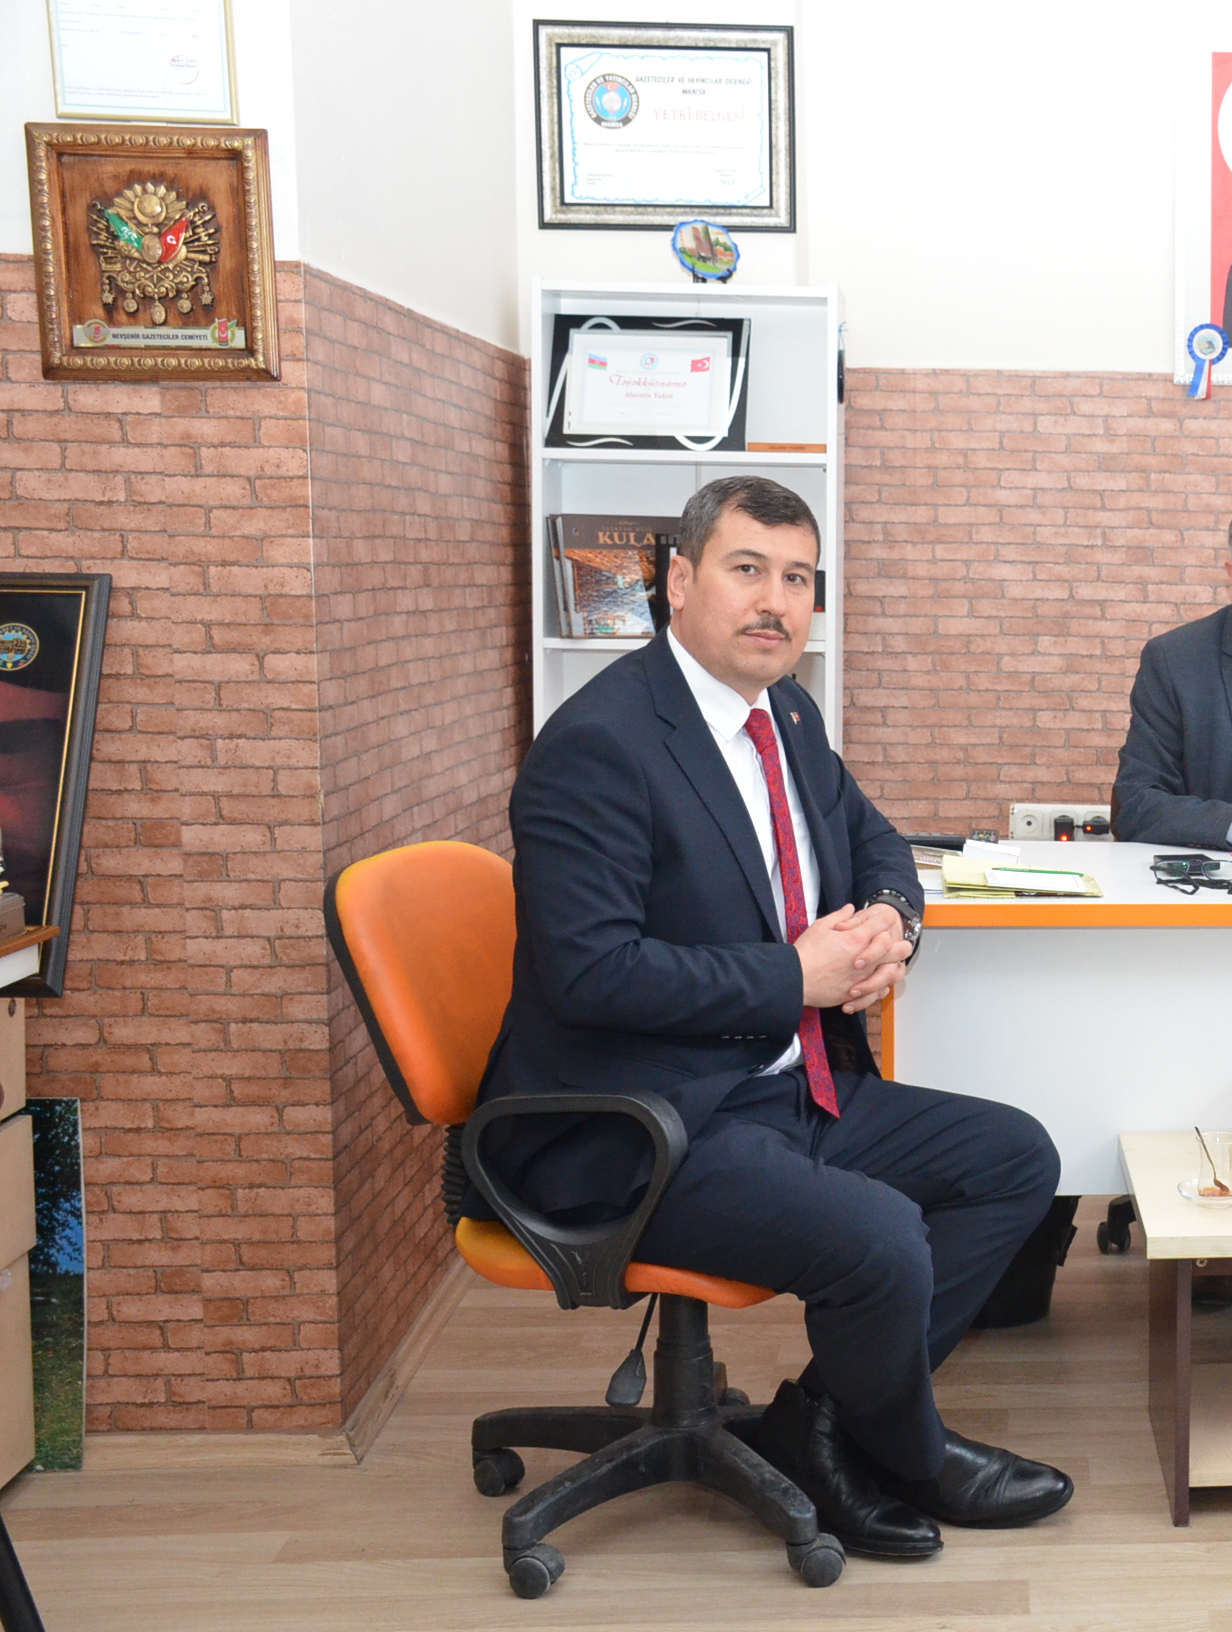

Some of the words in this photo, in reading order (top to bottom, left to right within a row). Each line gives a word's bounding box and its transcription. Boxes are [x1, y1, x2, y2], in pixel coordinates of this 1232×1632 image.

[653, 106, 692, 121] YETKİ
[695, 107, 745, 122] BELGESİ
[112, 333, 140, 341] NEVŞEHİR
[142, 333, 179, 341] GAZETECİLER
[181, 333, 208, 341] CEMİYETİ
[597, 531, 656, 548] KULA
